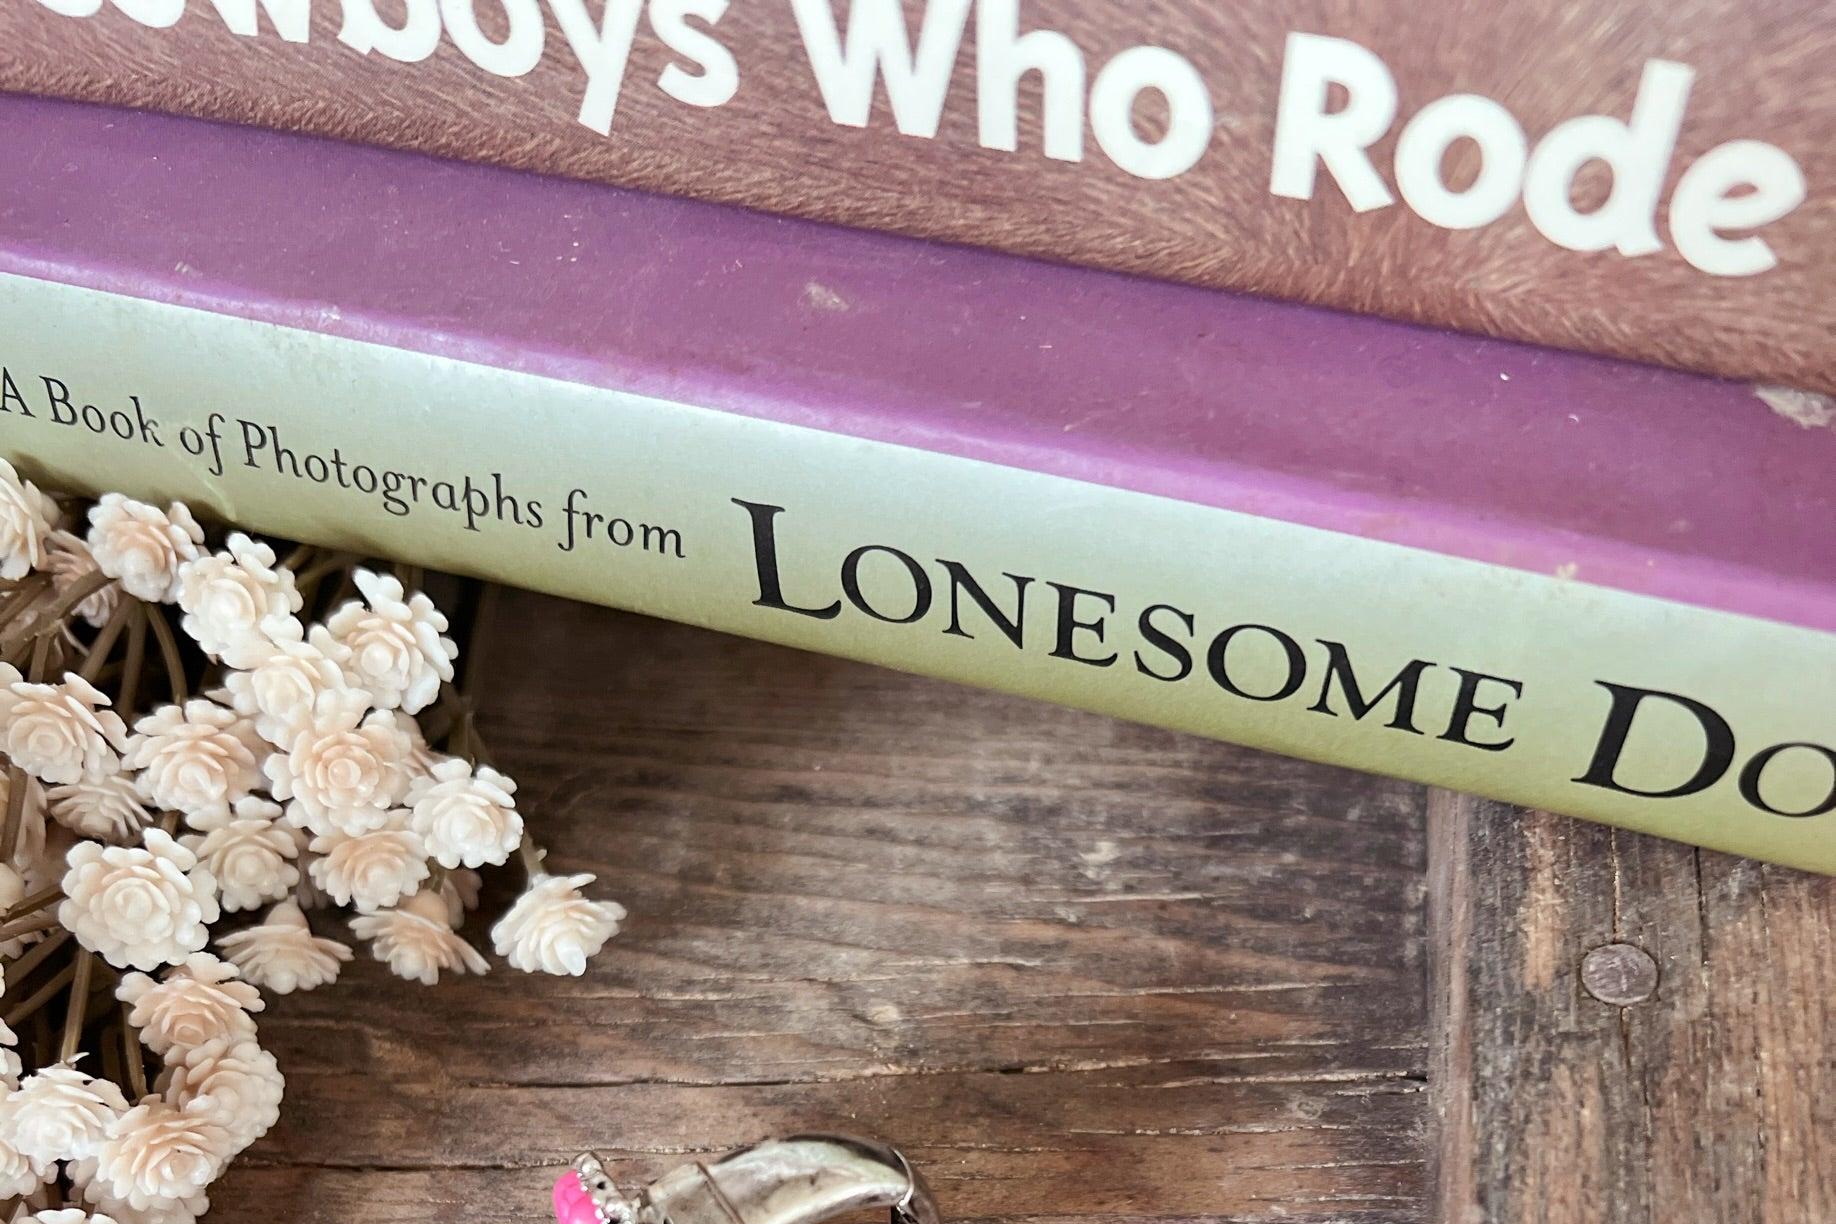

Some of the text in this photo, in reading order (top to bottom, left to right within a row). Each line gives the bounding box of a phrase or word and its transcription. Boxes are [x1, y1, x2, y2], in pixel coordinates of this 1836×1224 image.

[791, 0, 1212, 179] Who
[1271, 32, 1806, 276] Rode
[0, 367, 36, 418] A
[39, 375, 165, 447] Book
[180, 413, 226, 476] of
[236, 419, 544, 531] Photographs
[557, 489, 686, 558] from
[731, 498, 1523, 752] LONESOME
